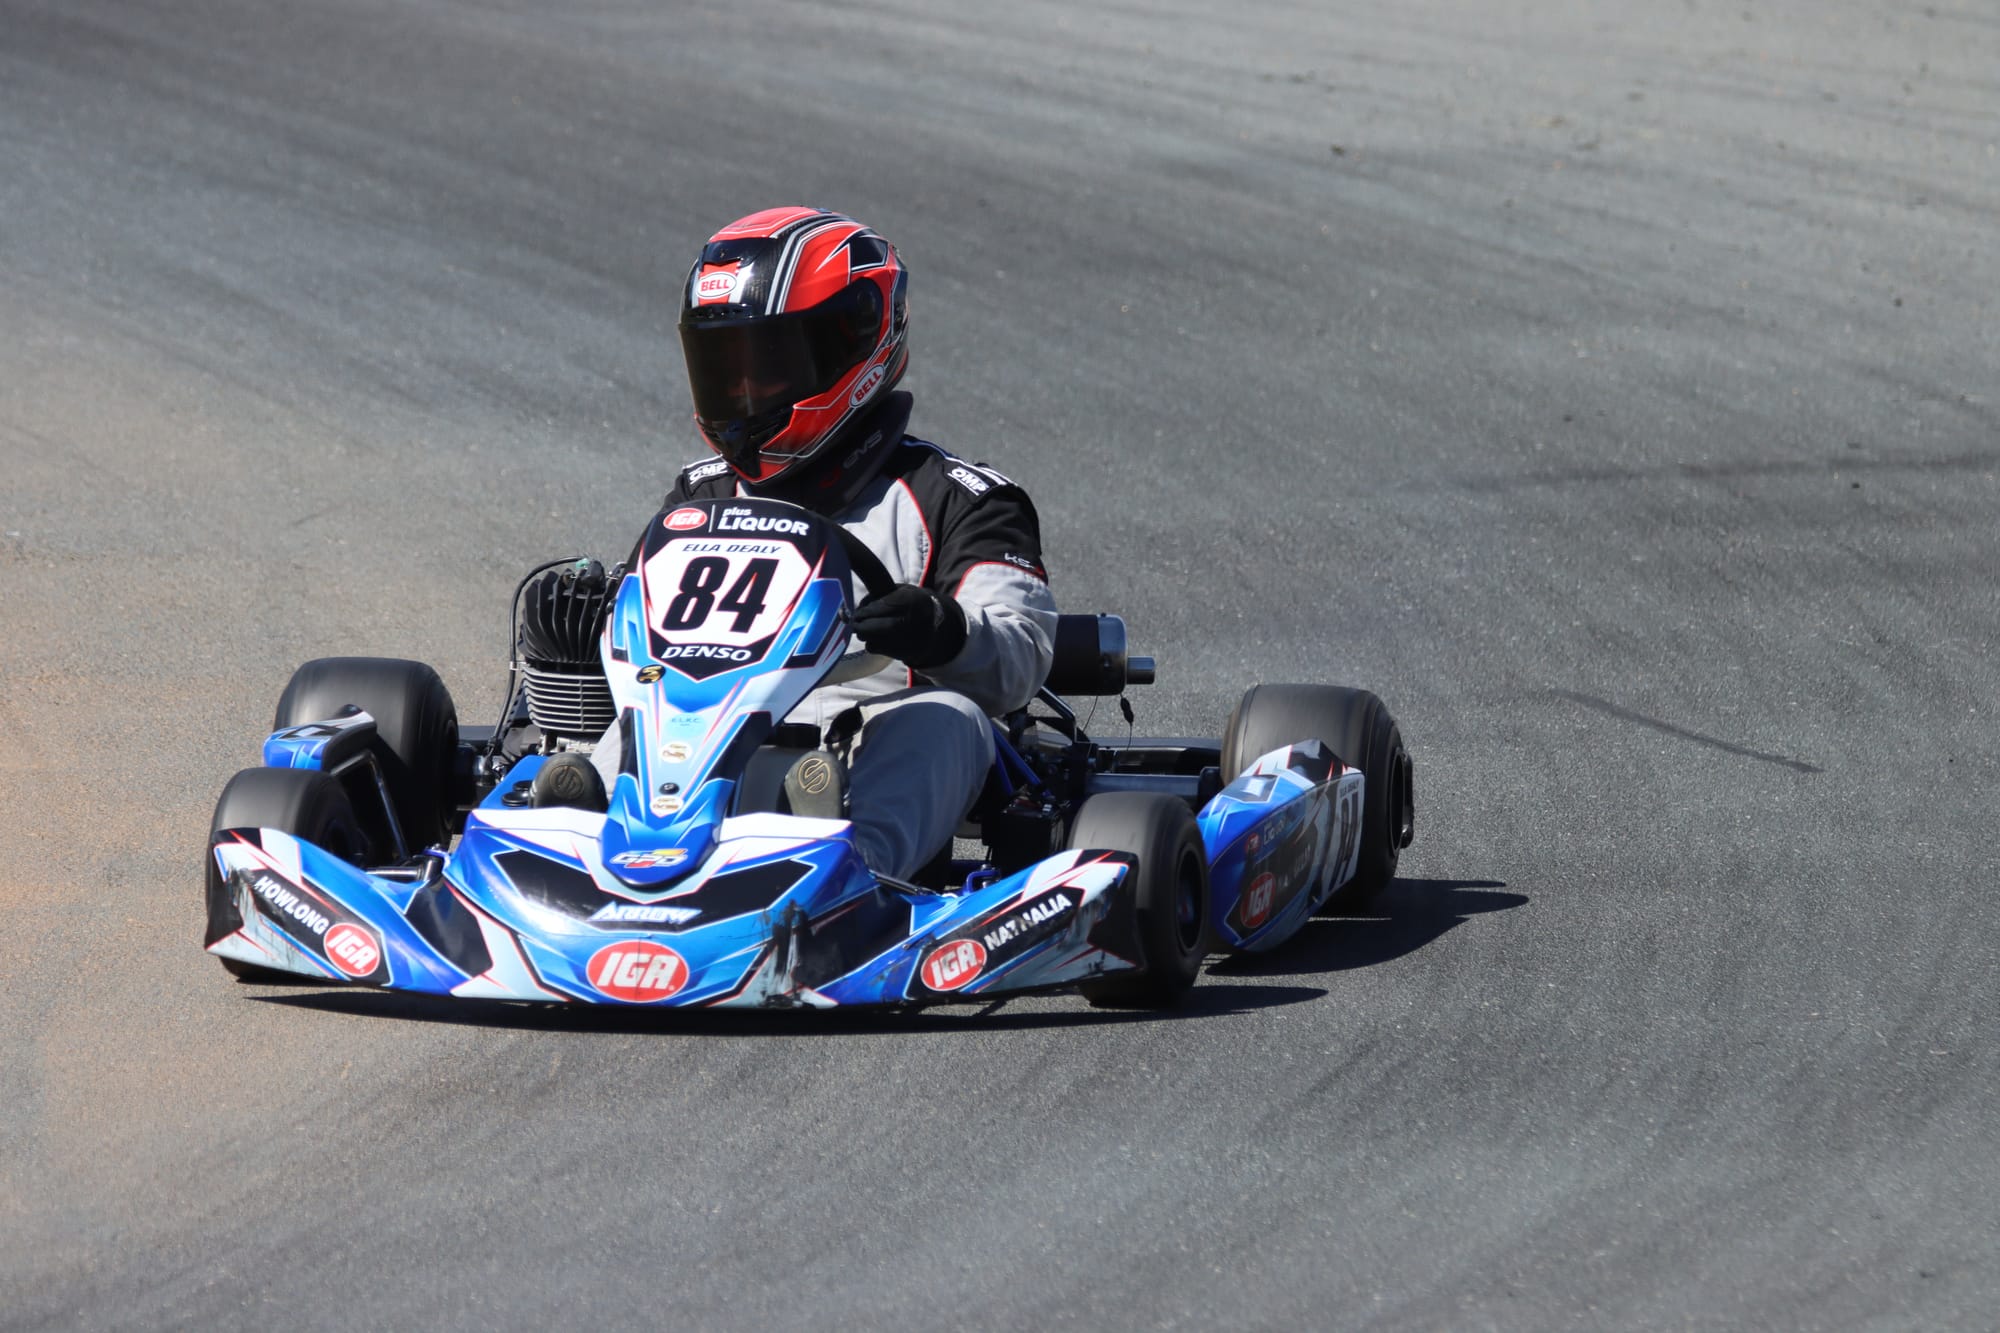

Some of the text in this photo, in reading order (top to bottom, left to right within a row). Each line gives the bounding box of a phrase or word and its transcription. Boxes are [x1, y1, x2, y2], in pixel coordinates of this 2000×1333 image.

[701, 279, 730, 291] BELL
[855, 372, 881, 402] BELL
[690, 462, 727, 481] OMP
[951, 468, 987, 492] OMP
[668, 511, 702, 527] IGA
[723, 507, 752, 516] plus
[717, 515, 809, 536] LIQUOR
[683, 543, 782, 554] ELLA DEALY
[661, 556, 780, 634] 84
[661, 645, 752, 662] DENSO
[1247, 878, 1273, 918] IGA
[253, 876, 378, 971] HOWLONG IGA
[930, 893, 1073, 988] IGA NATHALIA
[596, 952, 679, 990] IGA
